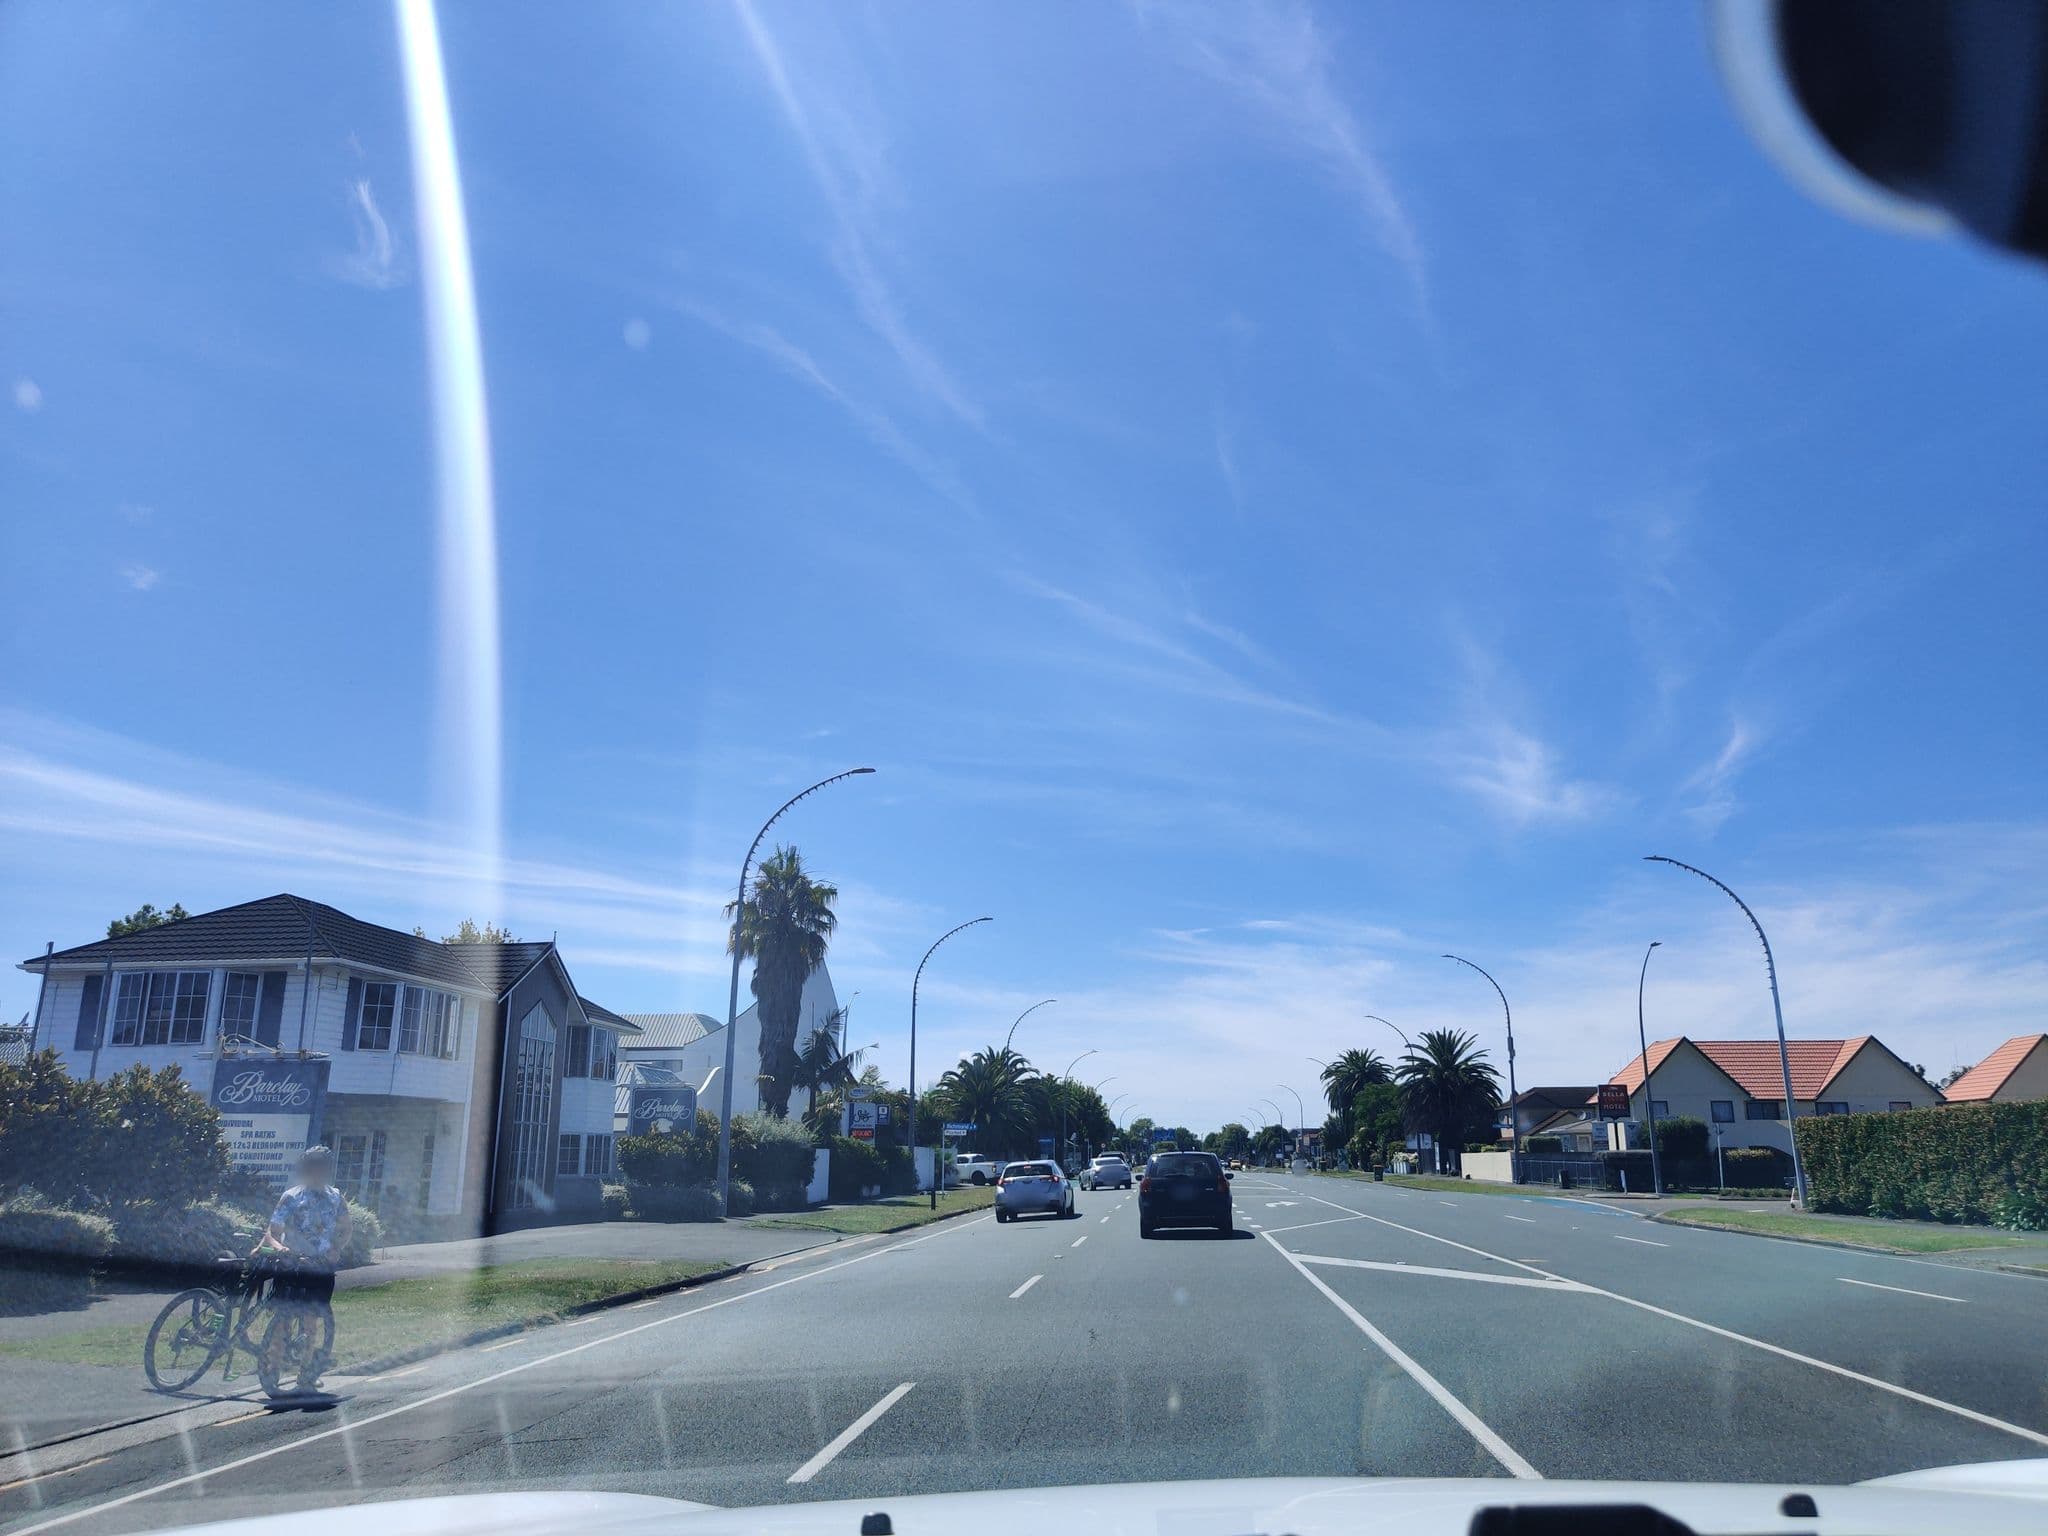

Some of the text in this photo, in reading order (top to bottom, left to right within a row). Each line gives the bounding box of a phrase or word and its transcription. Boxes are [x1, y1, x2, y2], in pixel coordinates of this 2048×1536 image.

[218, 1070, 311, 1106] Barclay
[253, 1094, 282, 1103] MOTEL
[634, 1097, 691, 1120] Barclay
[240, 1130, 277, 1139] SPA BATHS
[252, 1141, 284, 1149] BEDROOM
[239, 1152, 283, 1160] CONDITIONED
